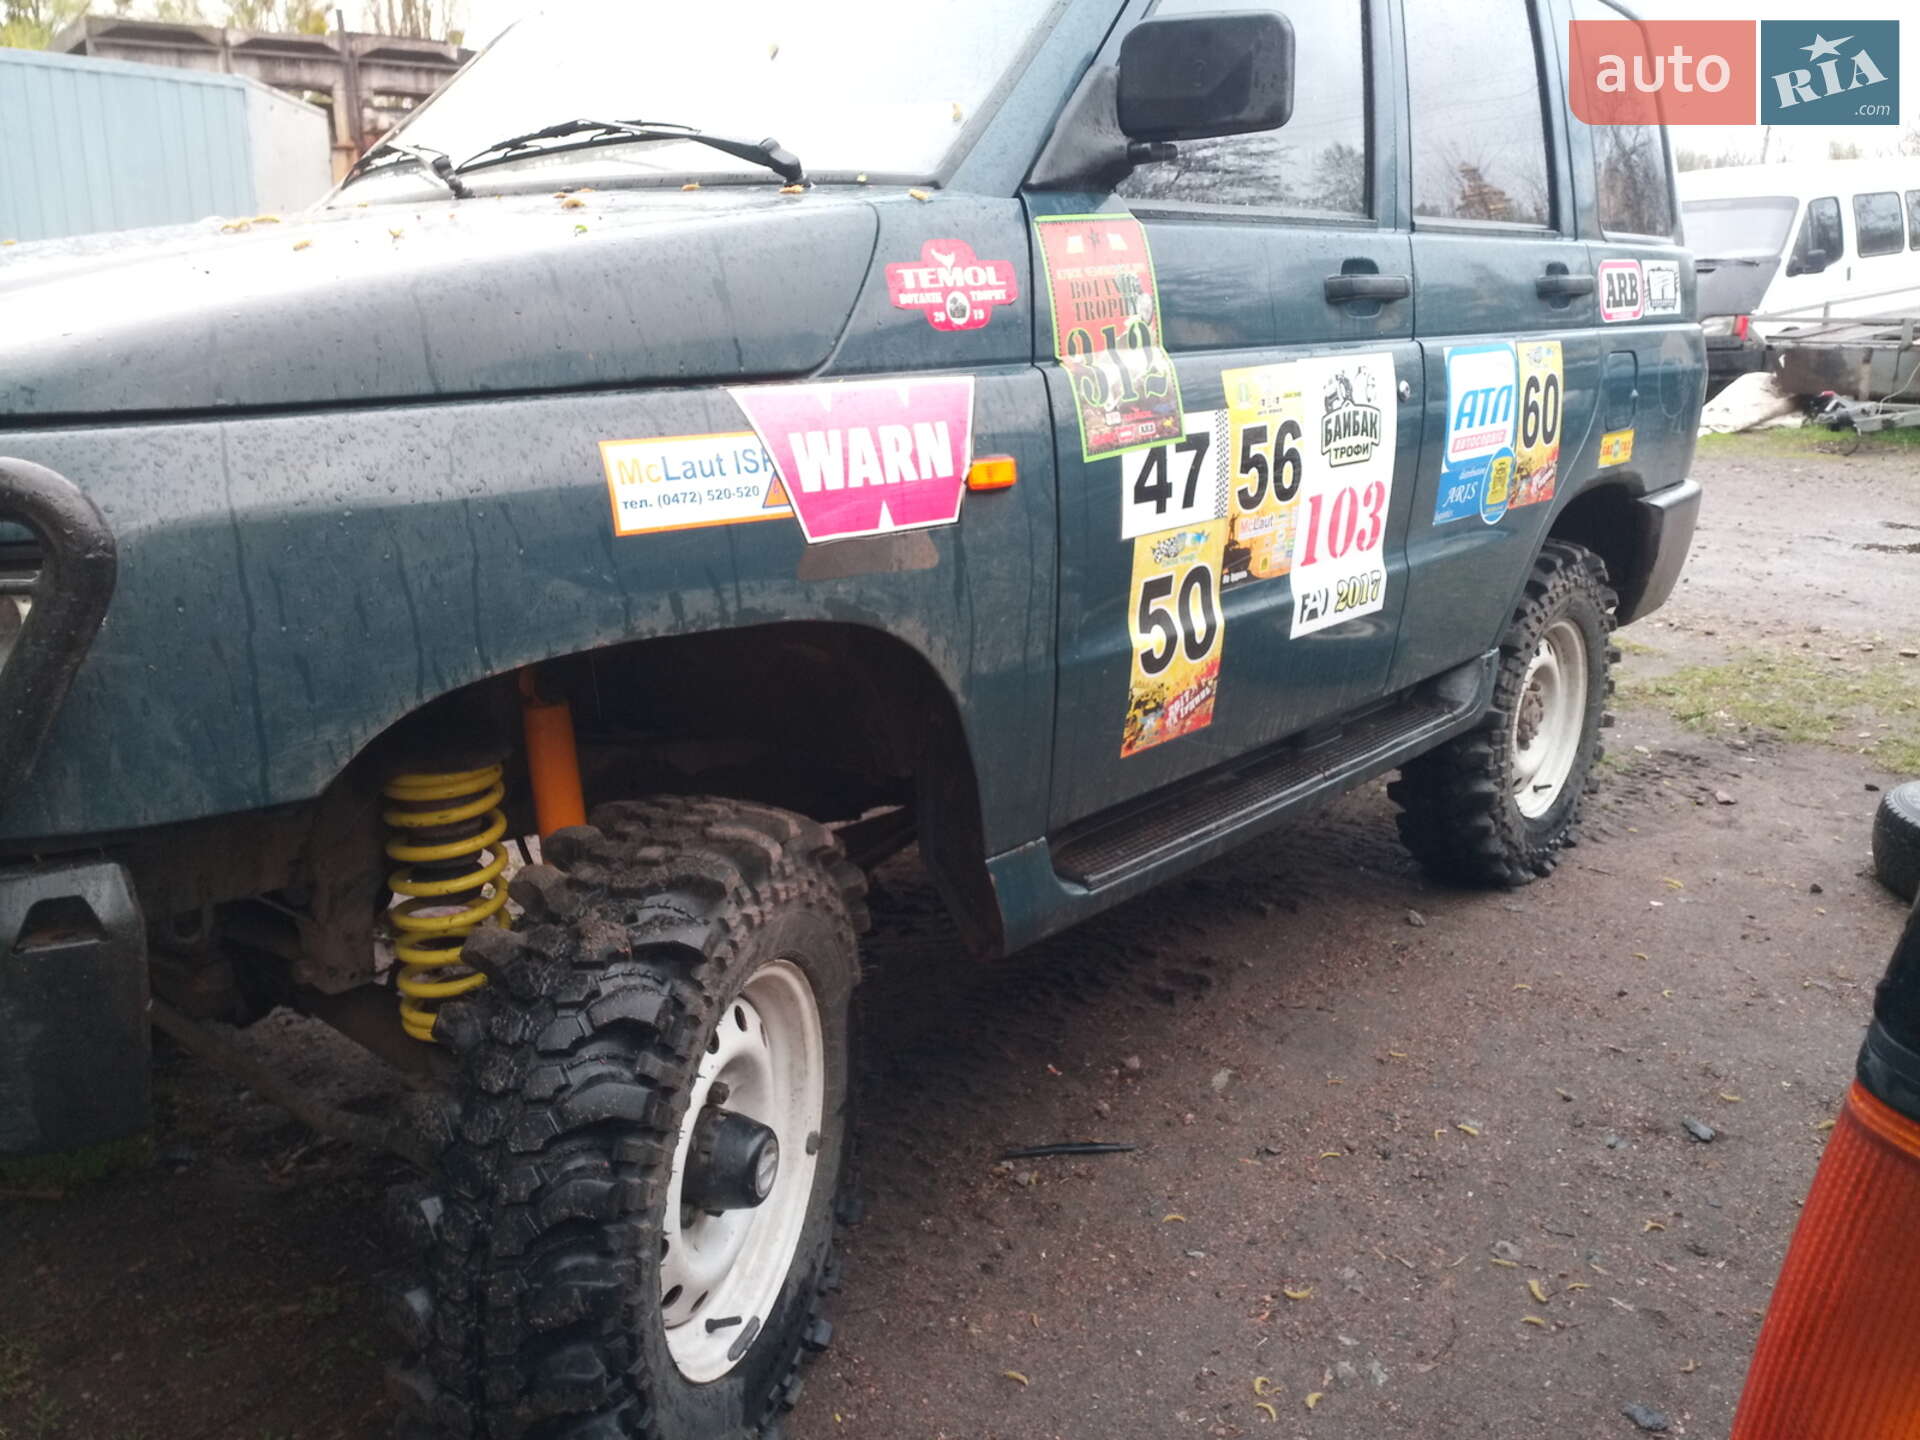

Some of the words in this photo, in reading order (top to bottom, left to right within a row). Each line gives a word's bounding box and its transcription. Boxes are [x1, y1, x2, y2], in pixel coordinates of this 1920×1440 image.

[896, 265, 1007, 289] TEMOL
[1606, 272, 1640, 309] ARB
[1074, 297, 1139, 322] TROPHY
[1067, 320, 1168, 408] 312
[1454, 384, 1514, 431] АТЛ
[1522, 374, 1559, 449] 60
[617, 452, 727, 486] McLaut
[788, 420, 954, 493] WARN
[1134, 432, 1210, 514] 47
[1237, 419, 1302, 511] 56
[1333, 446, 1369, 460] ТРОФИ
[623, 498, 654, 510] тел.
[657, 490, 703, 508] (0472)
[707, 484, 761, 502] 520-520
[1442, 481, 1479, 508] ARIS
[1301, 480, 1386, 567] 103
[1334, 570, 1382, 613] 2017
[1138, 565, 1218, 676] 50
